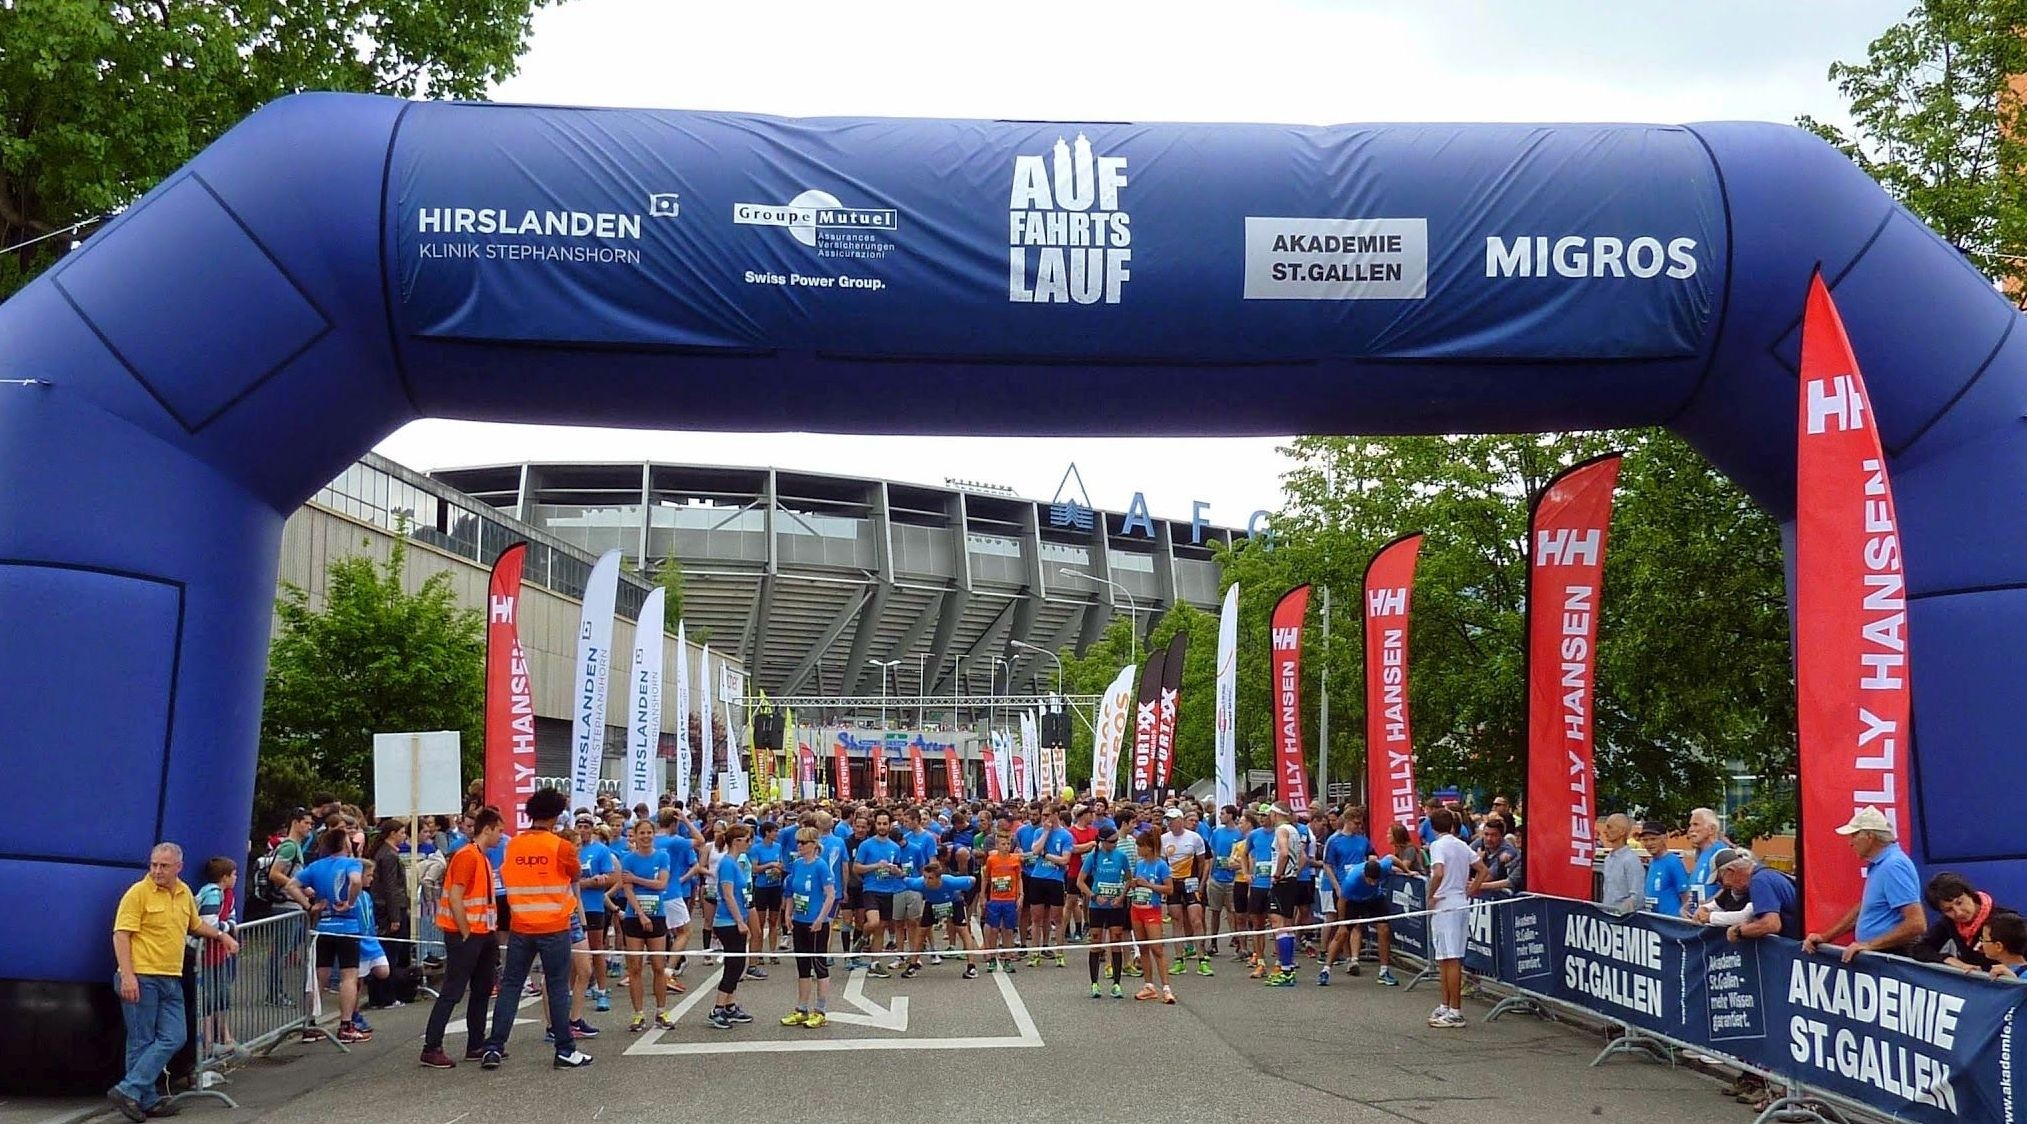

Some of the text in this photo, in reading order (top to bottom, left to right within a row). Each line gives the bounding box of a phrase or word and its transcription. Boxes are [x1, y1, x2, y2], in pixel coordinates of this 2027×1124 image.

[1010, 148, 1128, 210] AUF
[418, 207, 641, 239] HIRSLANDEN
[739, 206, 891, 226] Groupe Mutuel
[817, 231, 876, 242] Assurances
[1010, 212, 1131, 247] FAHRTS
[418, 243, 641, 264] KLINIK STEPHANSHORN
[817, 241, 895, 252] Versicherungen
[1271, 234, 1403, 254] AKADEMIE
[1485, 235, 1698, 280] MIGROS
[744, 270, 886, 291] Swiss Power Group.
[1009, 247, 1131, 305] LAUF
[1271, 262, 1403, 283] ST.GALLEN
[1537, 528, 1600, 567] HH
[1368, 587, 1406, 617] HH
[1272, 627, 1298, 650] HH
[1383, 629, 1406, 742] HANSEN
[576, 647, 598, 793] HIRSLANDEN
[634, 670, 649, 792] HIRSLANDEN
[1282, 661, 1308, 818] ELLY HANSEN
[1560, 585, 1594, 868] HELLY HANSEN
[1852, 708, 1898, 881] LLY
[515, 855, 549, 868] eupro
[1563, 913, 1662, 971] AKADEMIE
[1564, 954, 1662, 1018] ST.GALLEN
[1788, 958, 1966, 1051] AKADEMIE
[1788, 1014, 1959, 1116] ST.GALLEN
